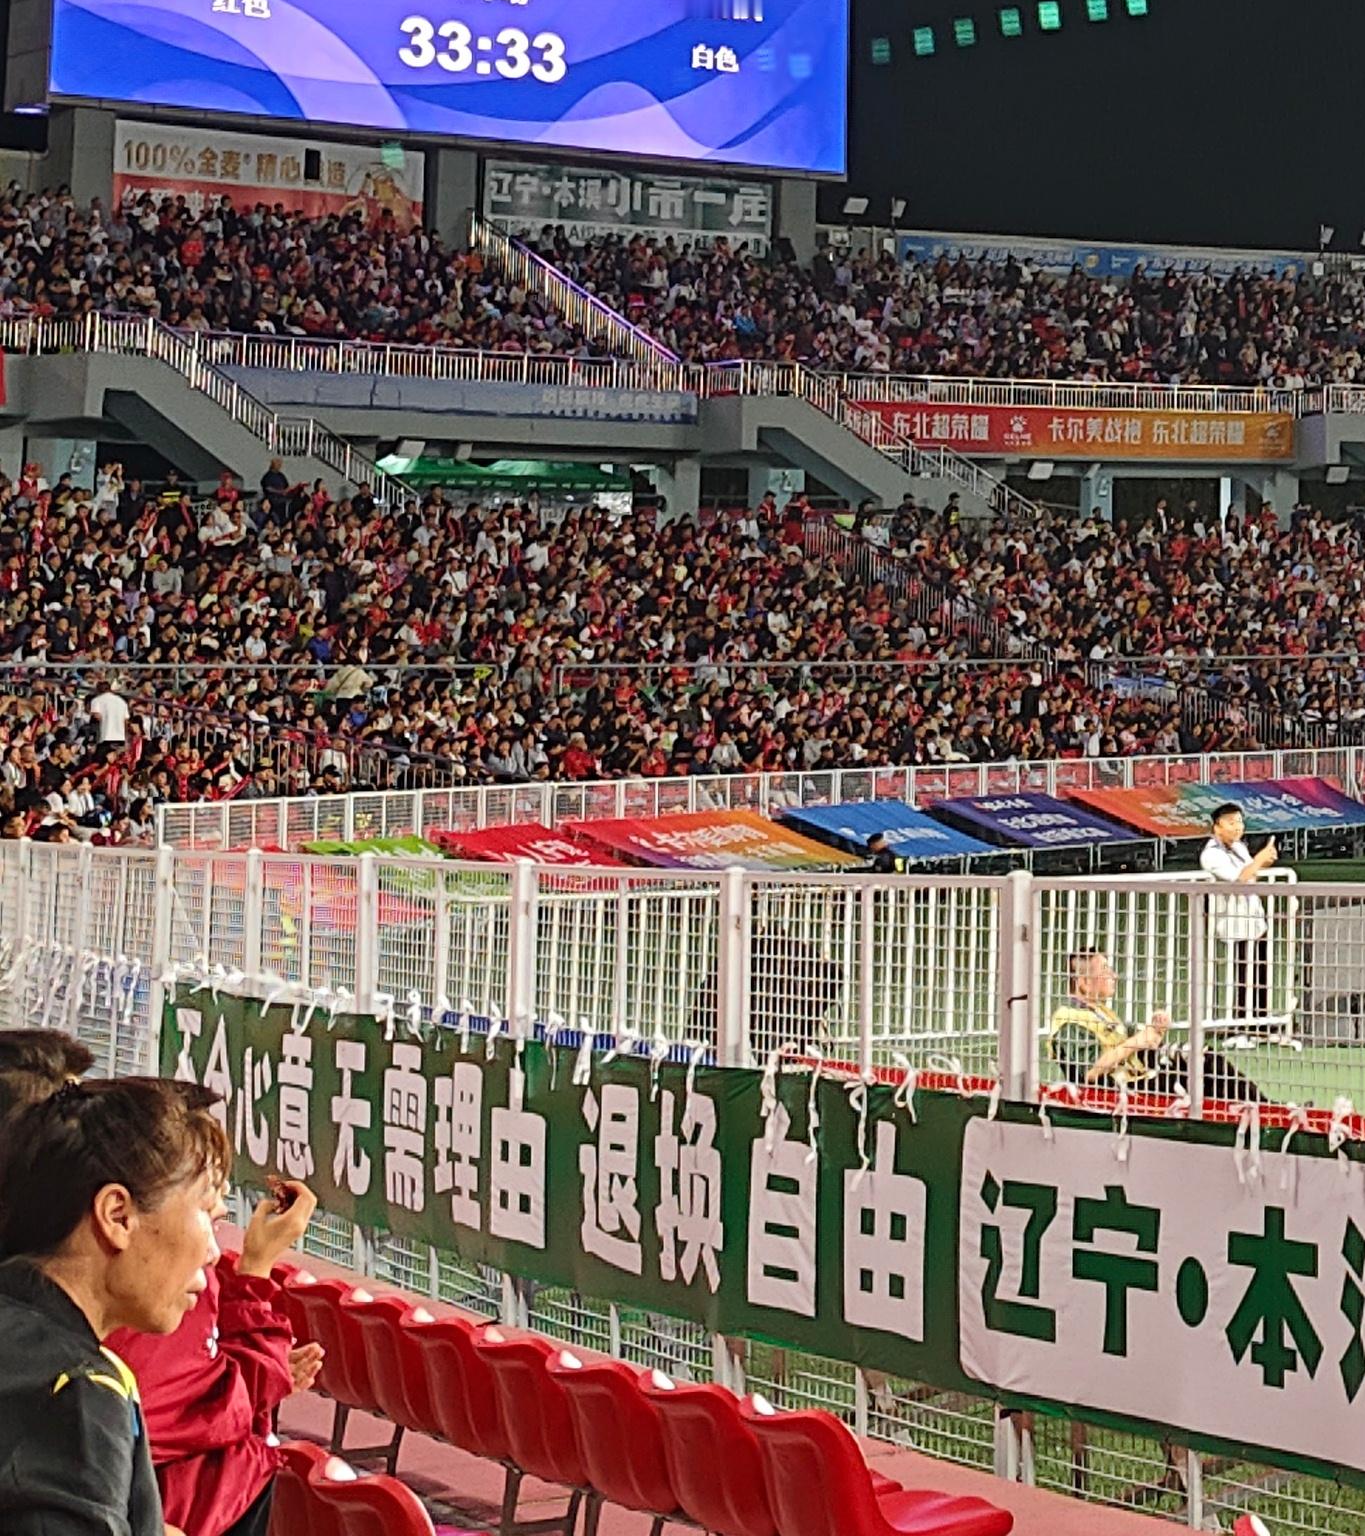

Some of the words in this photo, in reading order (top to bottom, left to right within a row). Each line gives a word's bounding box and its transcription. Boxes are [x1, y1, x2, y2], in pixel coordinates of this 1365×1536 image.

[398, 15, 567, 83] 33:33
[691, 43, 740, 73] 白色
[256, 151, 347, 189] 精心造
[607, 177, 767, 227] 小市一庄
[893, 411, 990, 441] 东北超荣耀
[1047, 416, 1143, 444] 卡尔美战袍
[1152, 418, 1246, 446] 东北超荣耀
[579, 1080, 928, 1344] 退换自由
